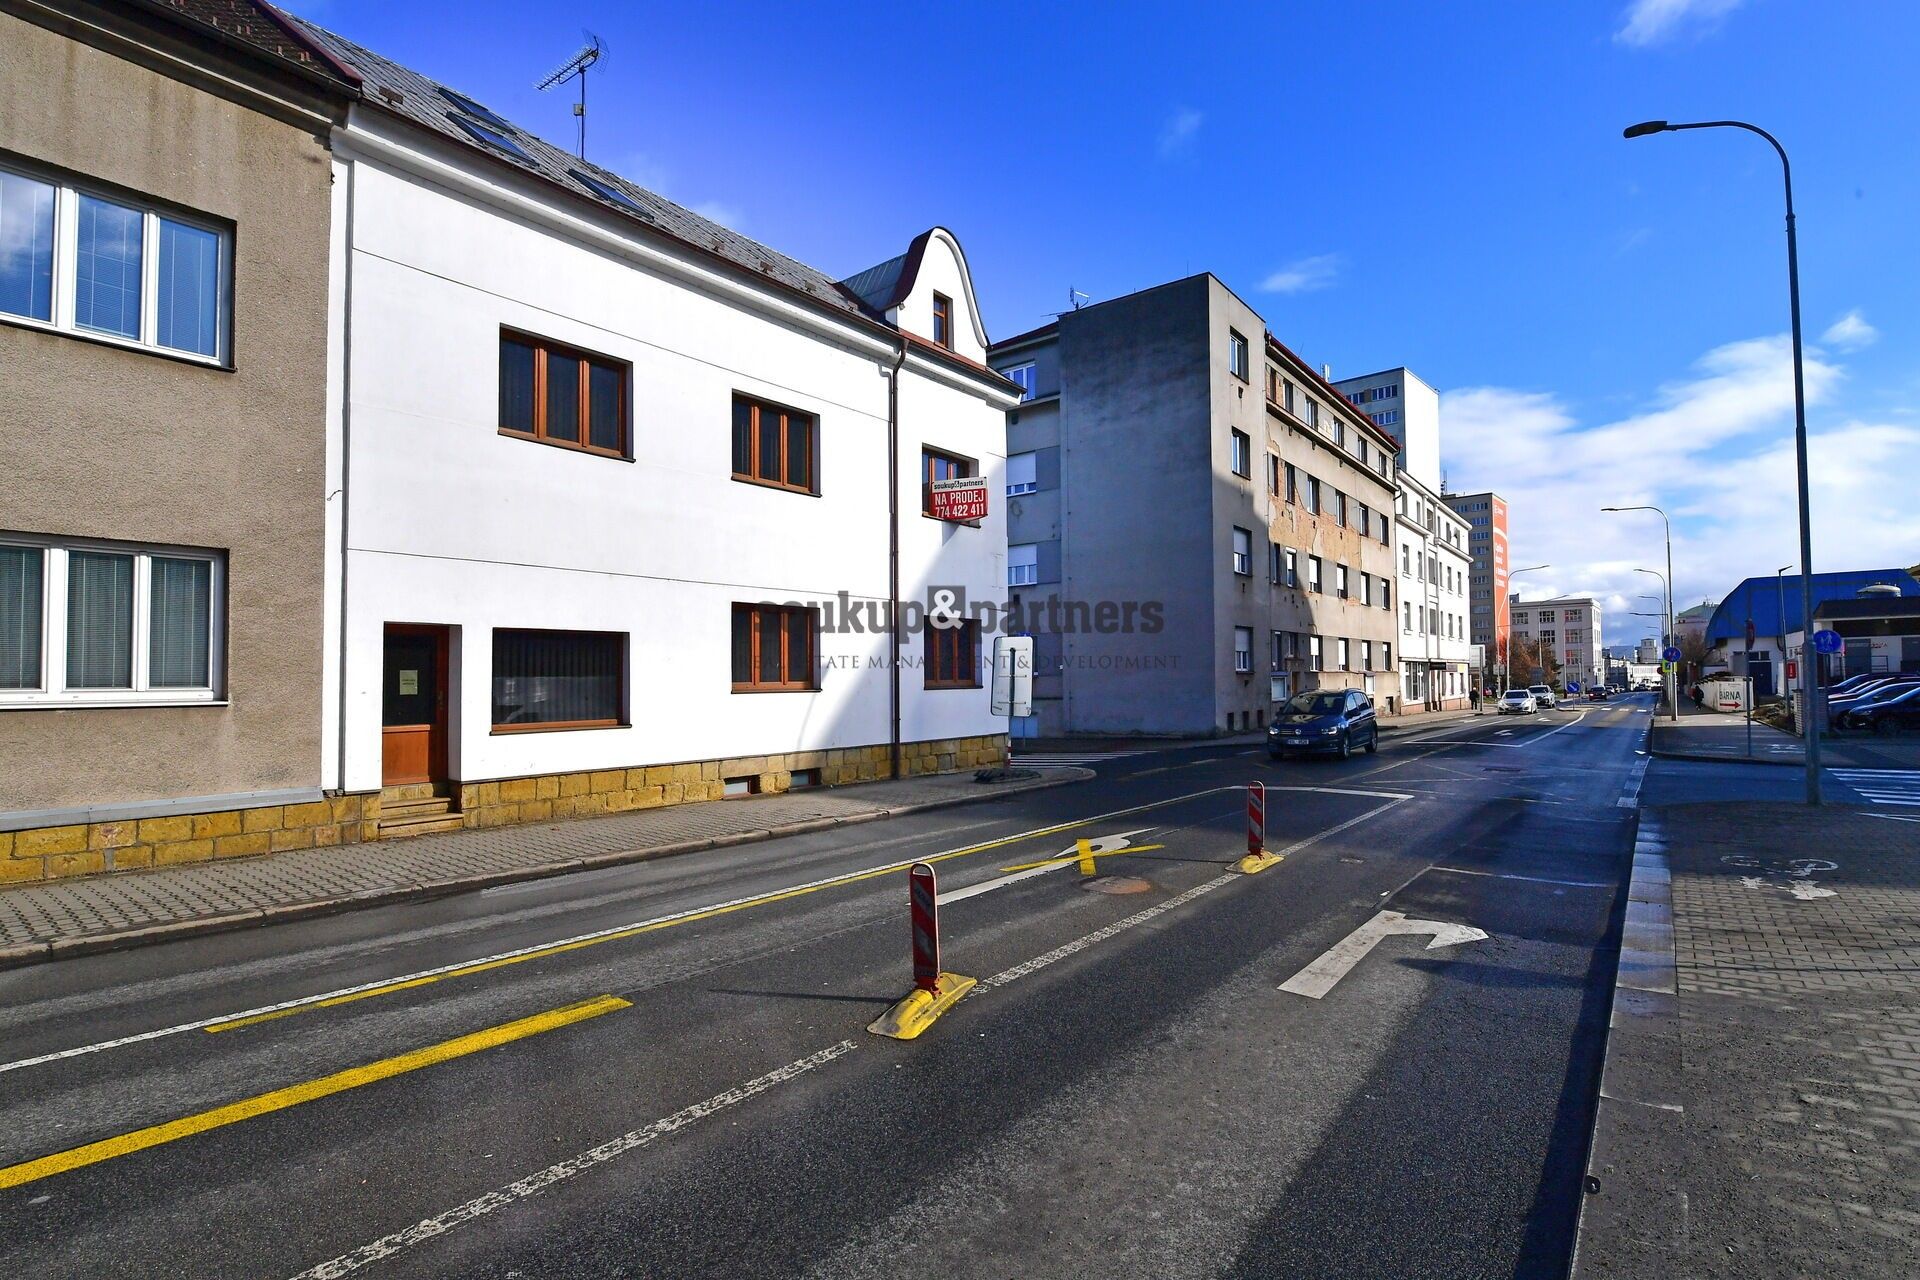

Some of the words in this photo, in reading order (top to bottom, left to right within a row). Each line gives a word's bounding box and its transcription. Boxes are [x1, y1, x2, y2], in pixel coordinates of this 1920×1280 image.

[935, 493, 947, 505] NA
[950, 490, 984, 504] PRODEJ
[935, 506, 950, 517] 774
[952, 504, 969, 517] 422
[970, 503, 984, 515] 411
